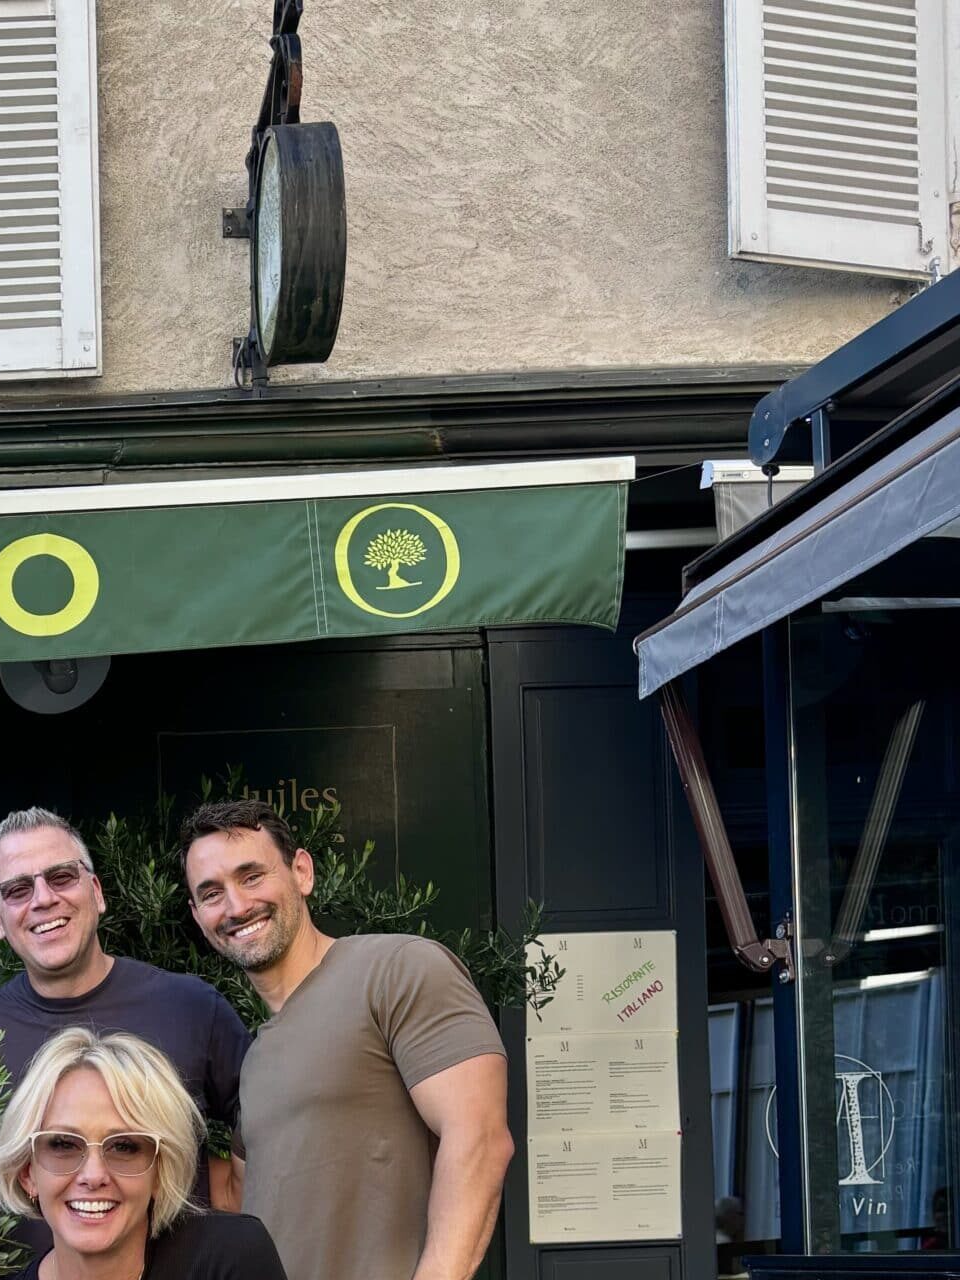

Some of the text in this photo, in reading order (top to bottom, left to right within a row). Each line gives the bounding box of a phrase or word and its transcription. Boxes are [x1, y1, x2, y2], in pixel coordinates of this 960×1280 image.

[602, 960, 656, 1004] RISTORANTE
[617, 980, 663, 1022] ITALIANO
[853, 1198, 887, 1216] Vin
